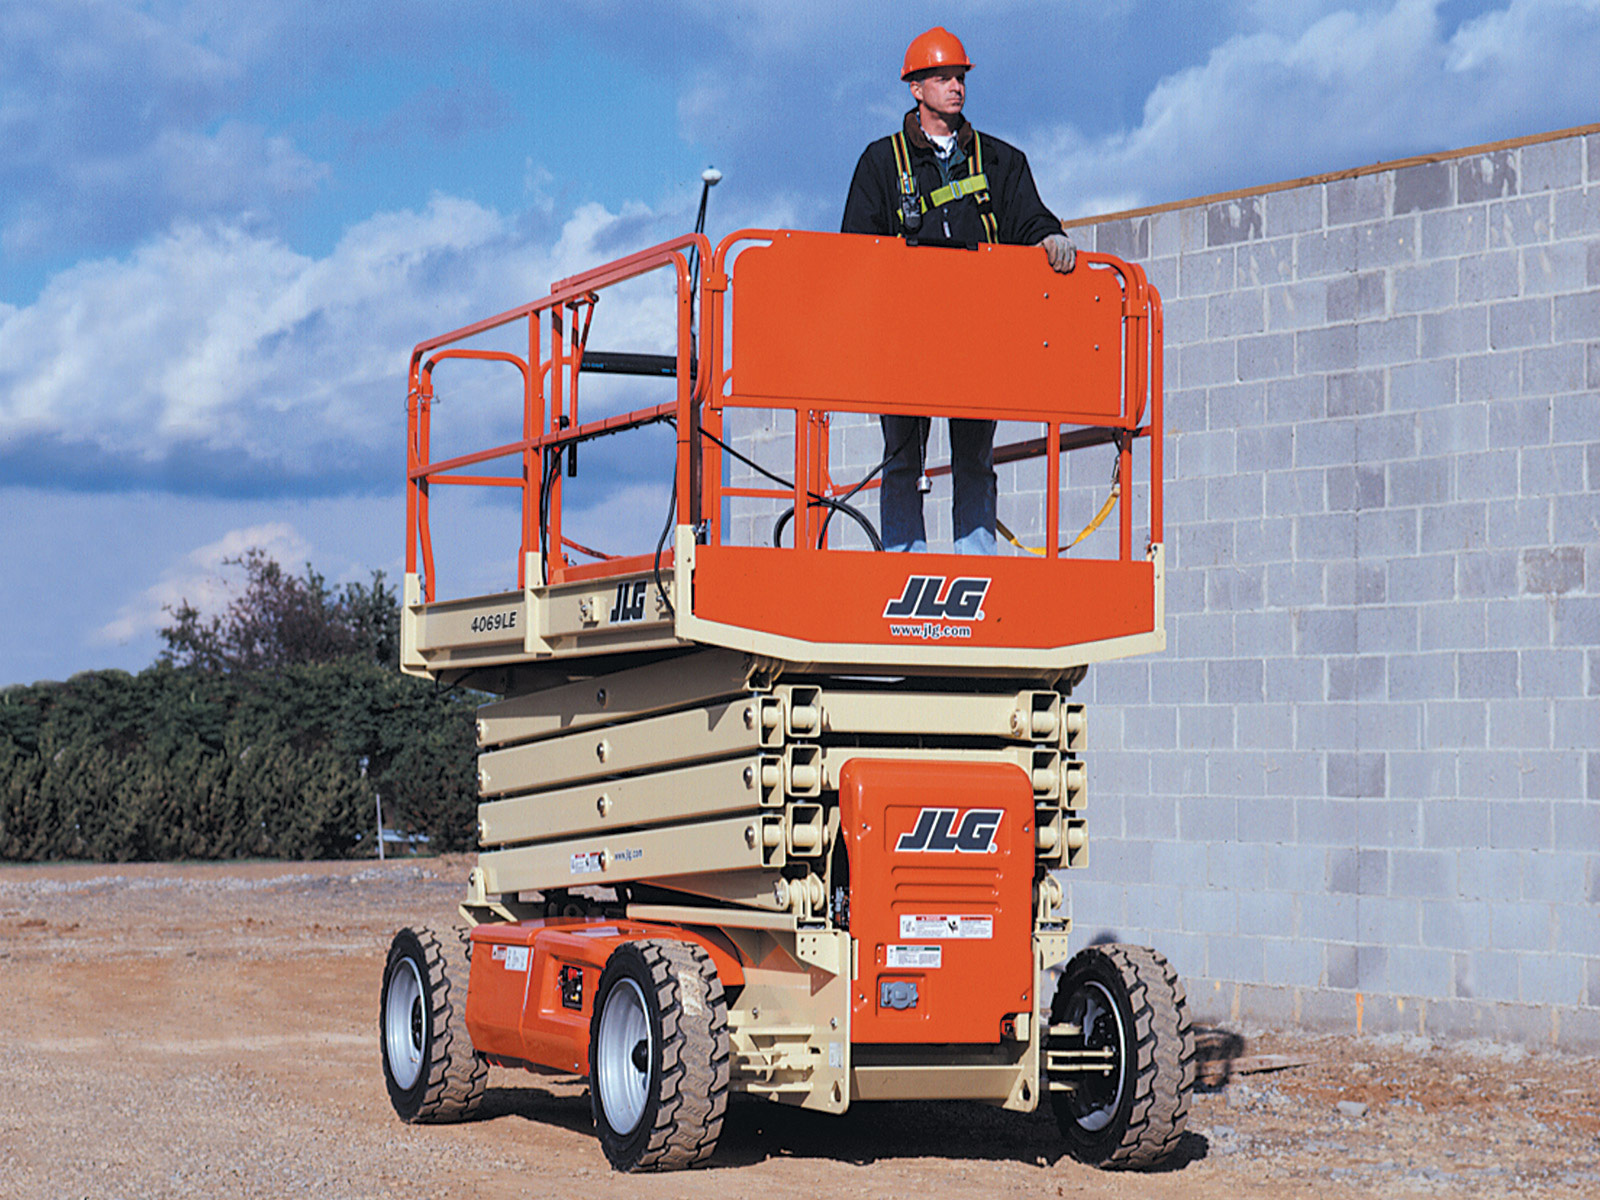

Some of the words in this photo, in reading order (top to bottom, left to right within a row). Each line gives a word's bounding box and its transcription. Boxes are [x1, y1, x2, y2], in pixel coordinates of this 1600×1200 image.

[610, 580, 647, 623] JLG
[882, 575, 991, 620] JLG
[470, 611, 517, 633] 4069LE
[890, 623, 971, 639] www.jlg.com
[894, 807, 1004, 853] JLG
